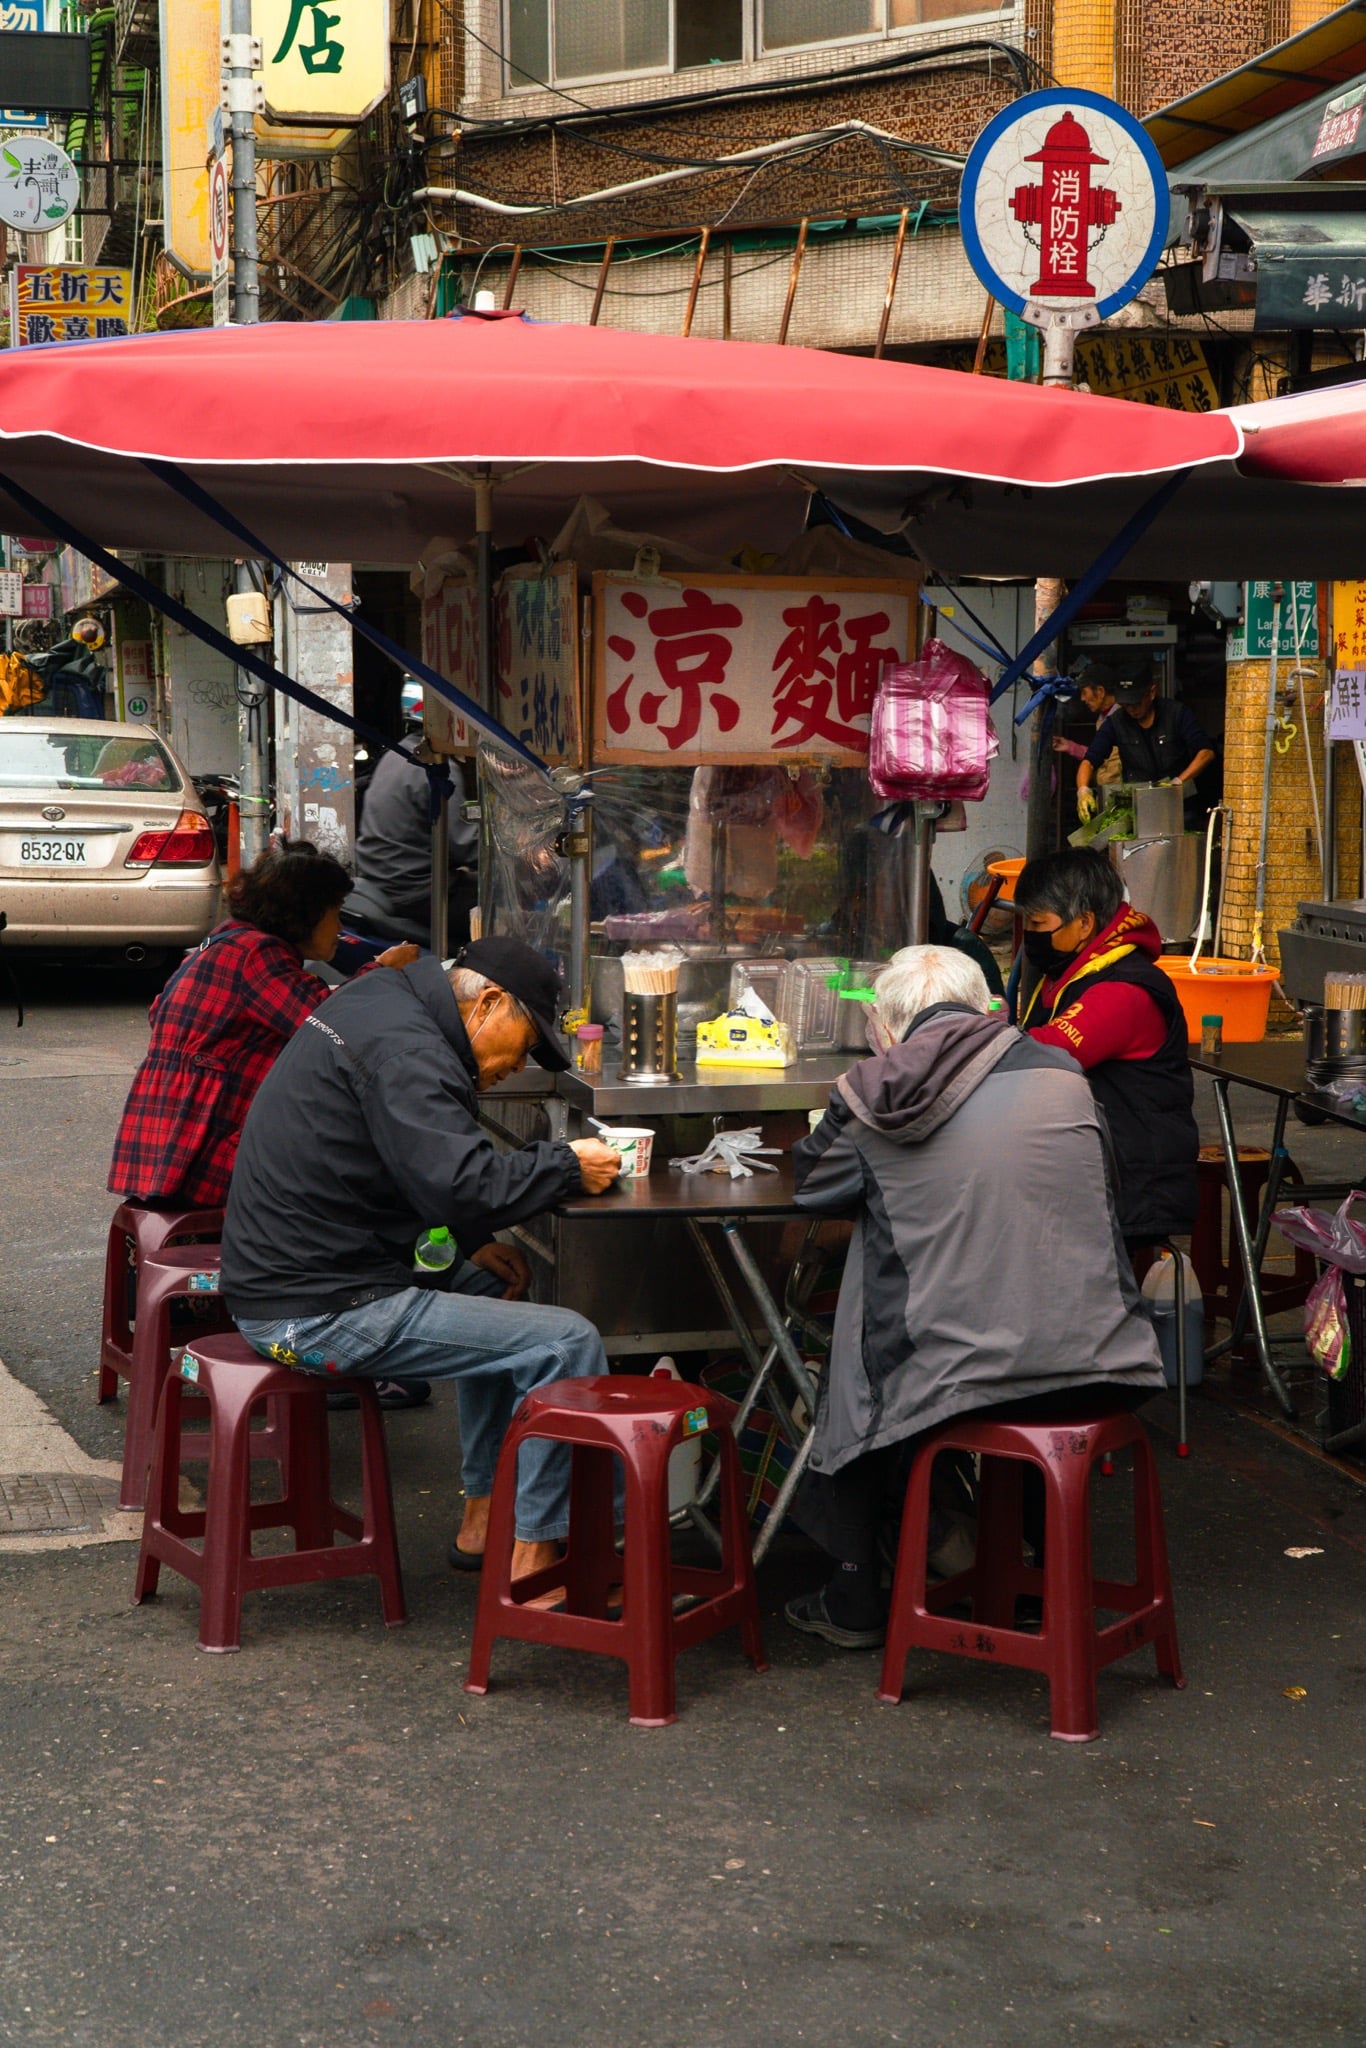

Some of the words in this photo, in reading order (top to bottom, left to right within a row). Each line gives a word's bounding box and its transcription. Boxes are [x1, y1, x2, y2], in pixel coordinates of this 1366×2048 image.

[272, 0, 344, 75] 店
[1049, 169, 1080, 275] 消防栓
[25, 272, 124, 304] 五折天
[607, 588, 899, 751] 涼麵
[1258, 636, 1318, 651] KangDng
[1332, 675, 1366, 723] 鮮
